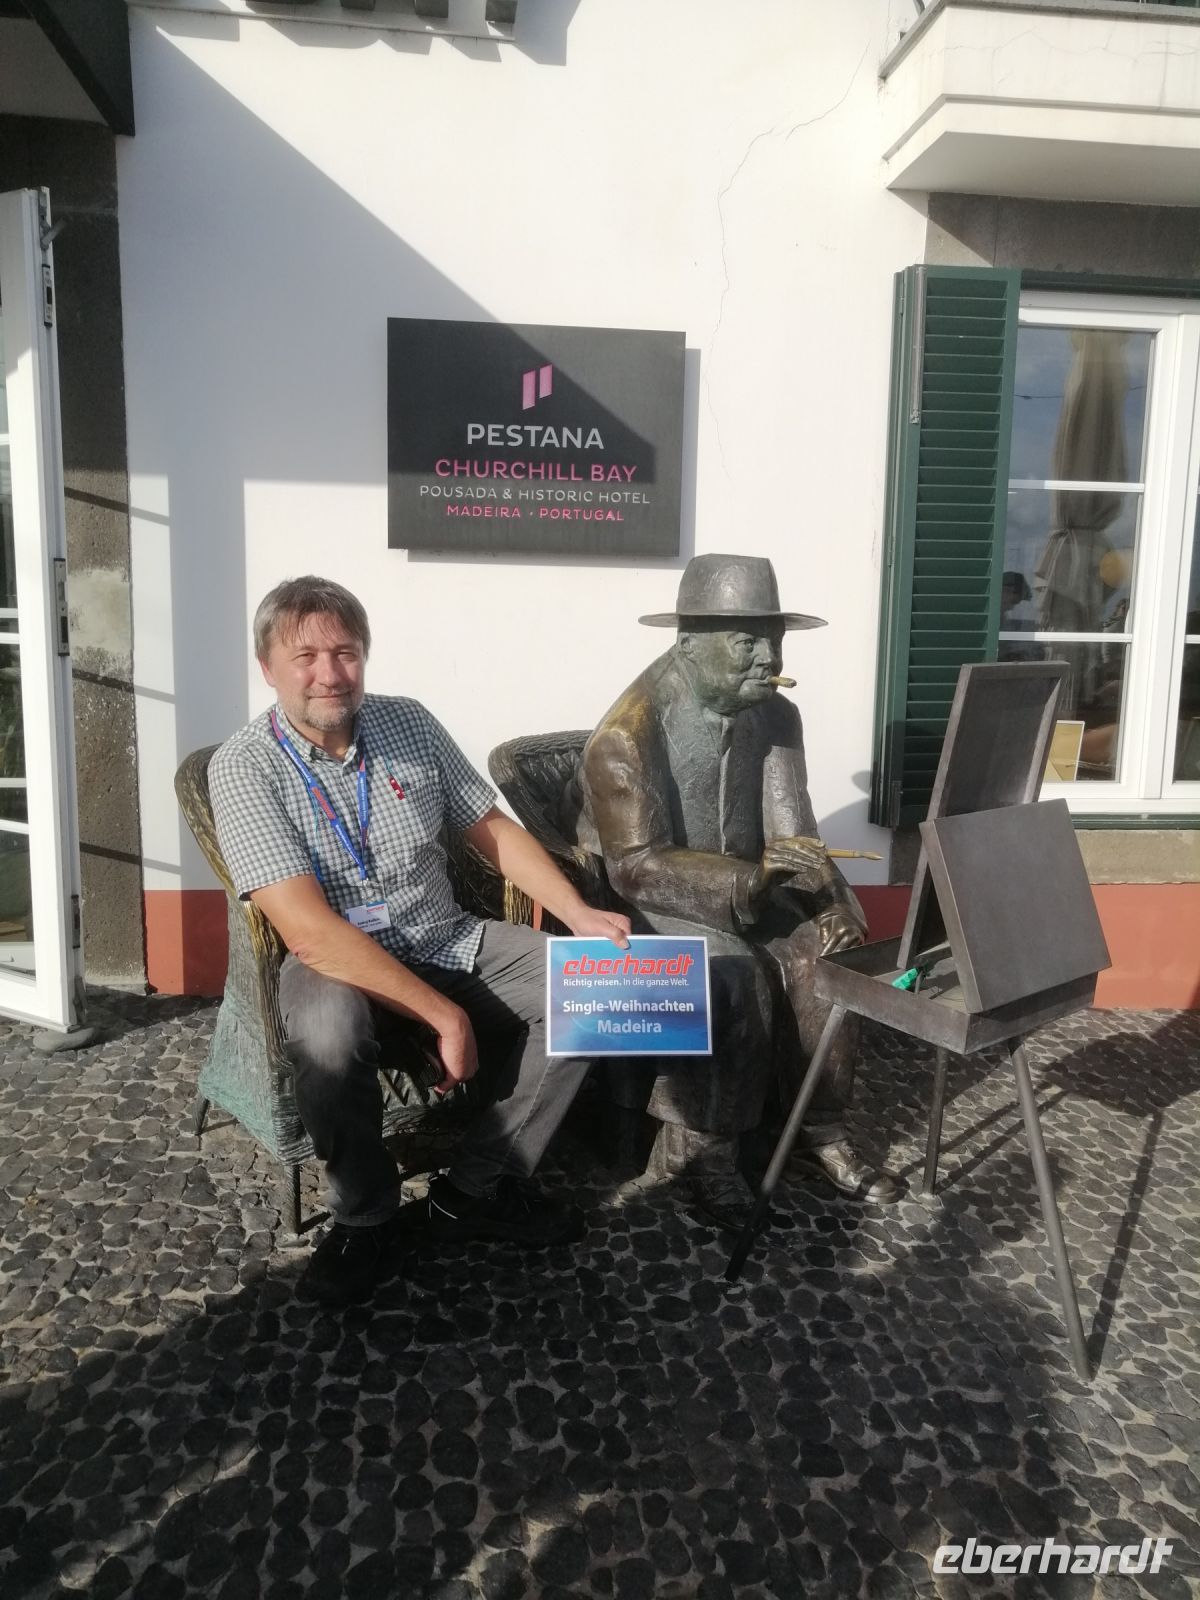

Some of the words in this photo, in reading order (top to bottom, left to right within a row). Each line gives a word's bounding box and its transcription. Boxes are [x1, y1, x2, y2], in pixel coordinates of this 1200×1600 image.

[467, 423, 604, 450] PESTANA
[435, 459, 583, 482] CHURCHILL
[590, 465, 637, 482] BAY
[420, 485, 497, 499] POUSADA
[503, 487, 512, 499] &
[519, 489, 593, 503] HISTORIC
[599, 492, 650, 504] HOTEL
[447, 505, 521, 518] MADEIRA
[539, 508, 625, 521] PORTUGAL
[563, 954, 694, 976] eberhardt
[563, 978, 593, 987] Richtig
[594, 978, 621, 986] reisen.
[623, 978, 631, 986] In
[632, 978, 644, 986] die
[646, 979, 669, 988] ganze
[670, 978, 690, 986] Welt.
[563, 1000, 694, 1015] Single-Weihnachten
[597, 1019, 662, 1033] Madeira
